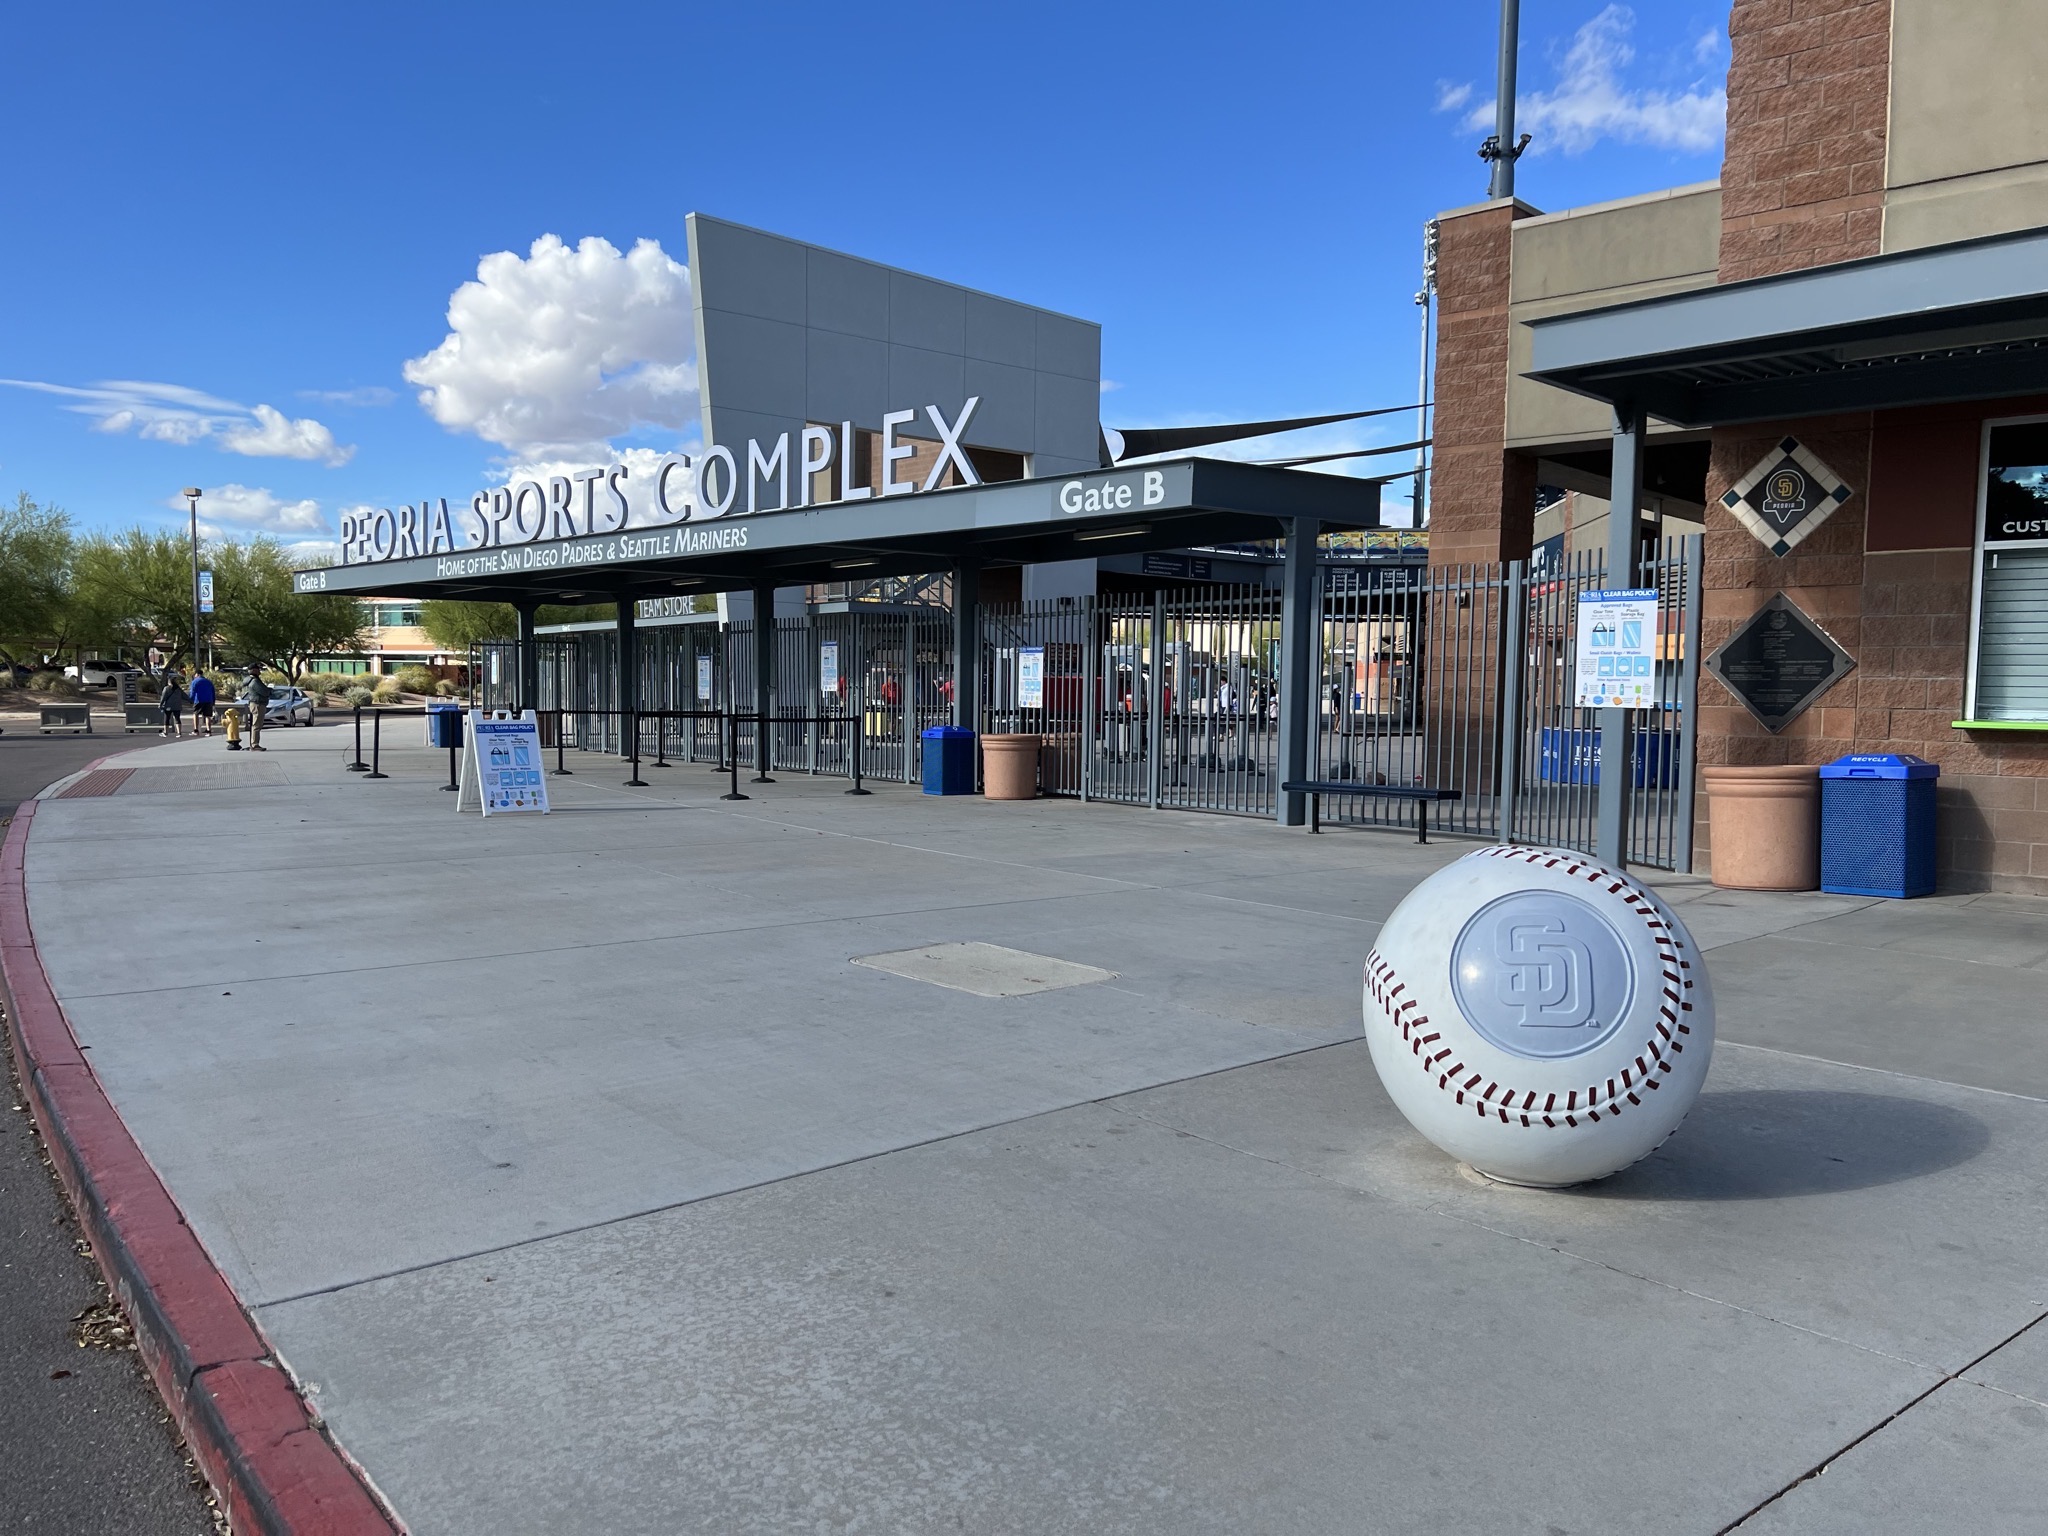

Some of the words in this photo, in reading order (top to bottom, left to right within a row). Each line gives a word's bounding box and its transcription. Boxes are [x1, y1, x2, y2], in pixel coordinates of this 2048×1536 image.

[341, 498, 454, 565] PEORIA
[470, 463, 629, 548] SPORTS
[654, 396, 984, 523] COMPLEX
[1060, 480, 1132, 514] Gate
[1143, 471, 1165, 506] B
[467, 558, 480, 575] OF
[479, 555, 498, 573] THE
[501, 550, 521, 570] SAN
[523, 547, 557, 568] DIEGO
[606, 542, 616, 560] &
[300, 573, 318, 591] Gate
[320, 571, 326, 588] B
[1603, 590, 1621, 598] CLEAR
[637, 598, 663, 618] TEAM
[664, 595, 696, 616] STORE
